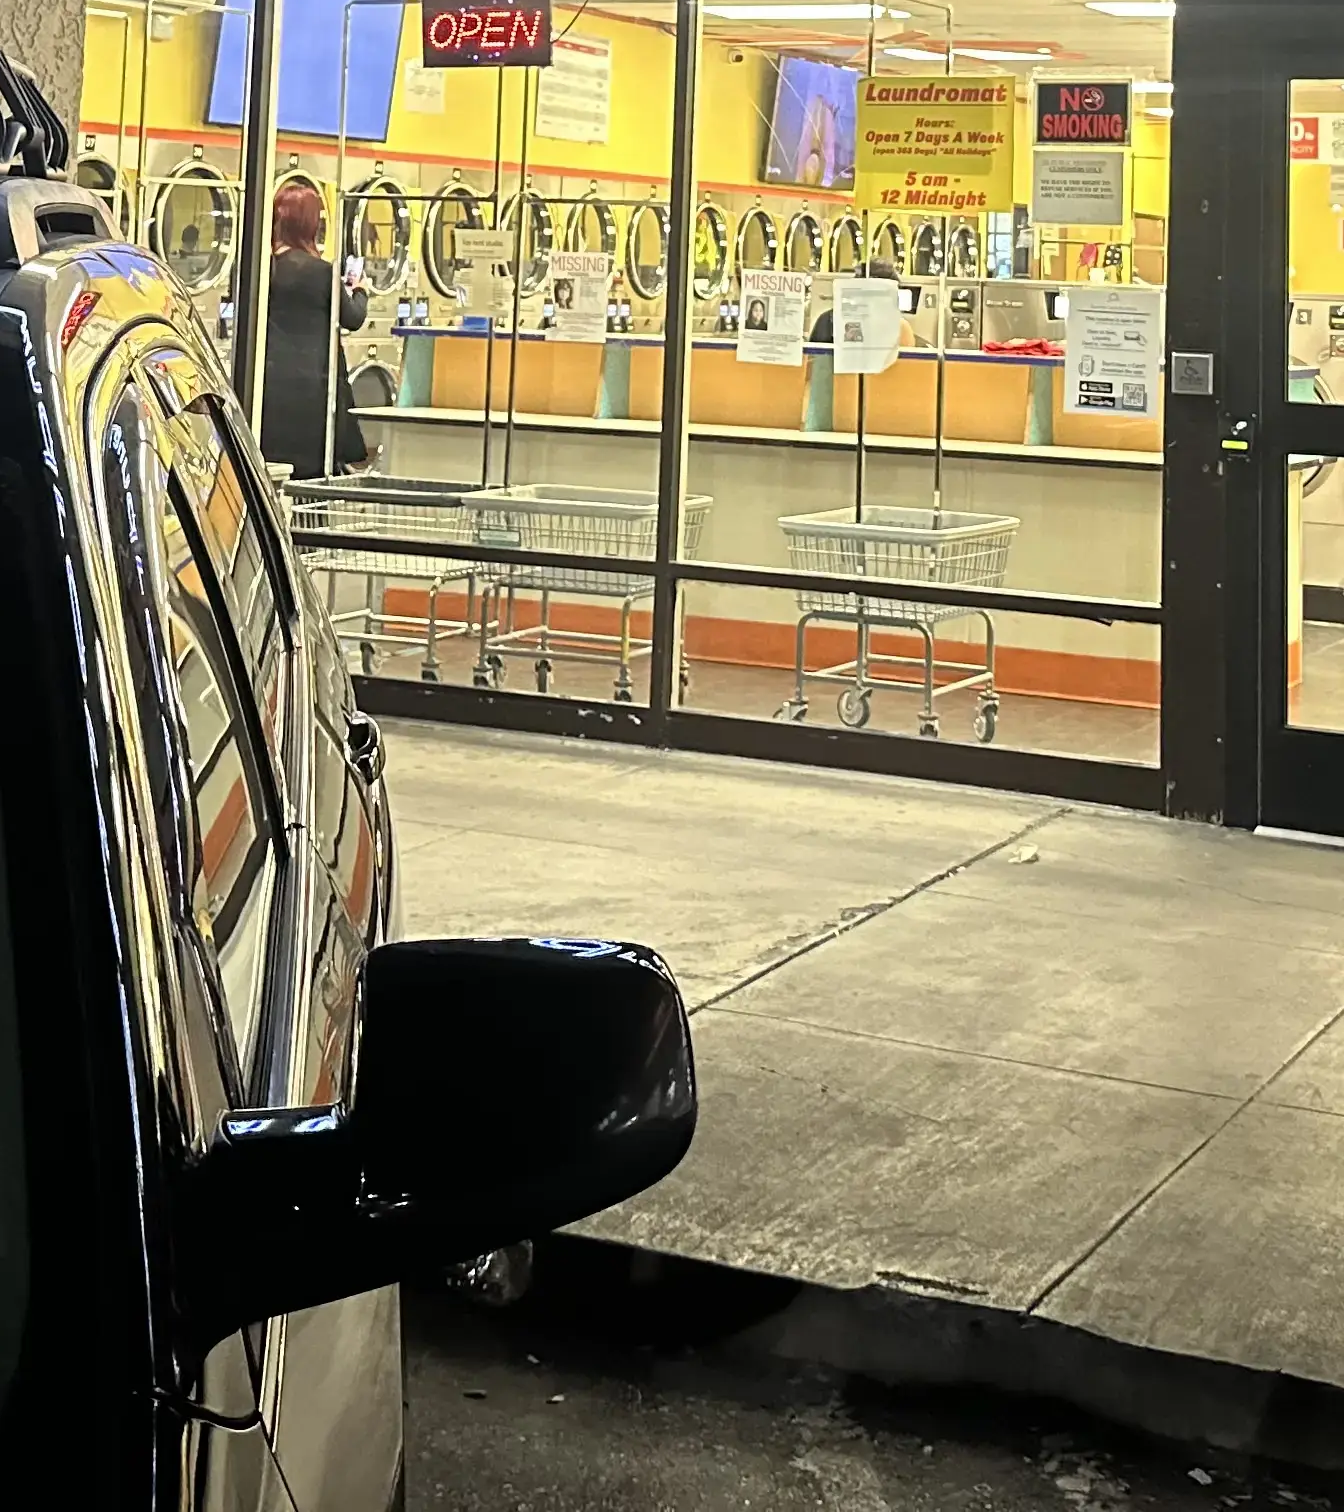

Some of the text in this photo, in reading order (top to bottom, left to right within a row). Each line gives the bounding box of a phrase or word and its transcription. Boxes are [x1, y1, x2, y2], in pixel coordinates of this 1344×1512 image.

[429, 9, 543, 50] OPEN
[865, 82, 1007, 103] Laundromat
[1059, 86, 1105, 112] NO
[915, 117, 955, 129] Hours:
[1042, 113, 1123, 138] SMOKING
[865, 130, 1005, 146] Open 7 Days A Week
[905, 171, 917, 187] 5
[921, 174, 948, 187] am
[880, 189, 987, 210] 12 Midnight
[551, 254, 605, 273] MISSING
[744, 273, 803, 293] MISSING
